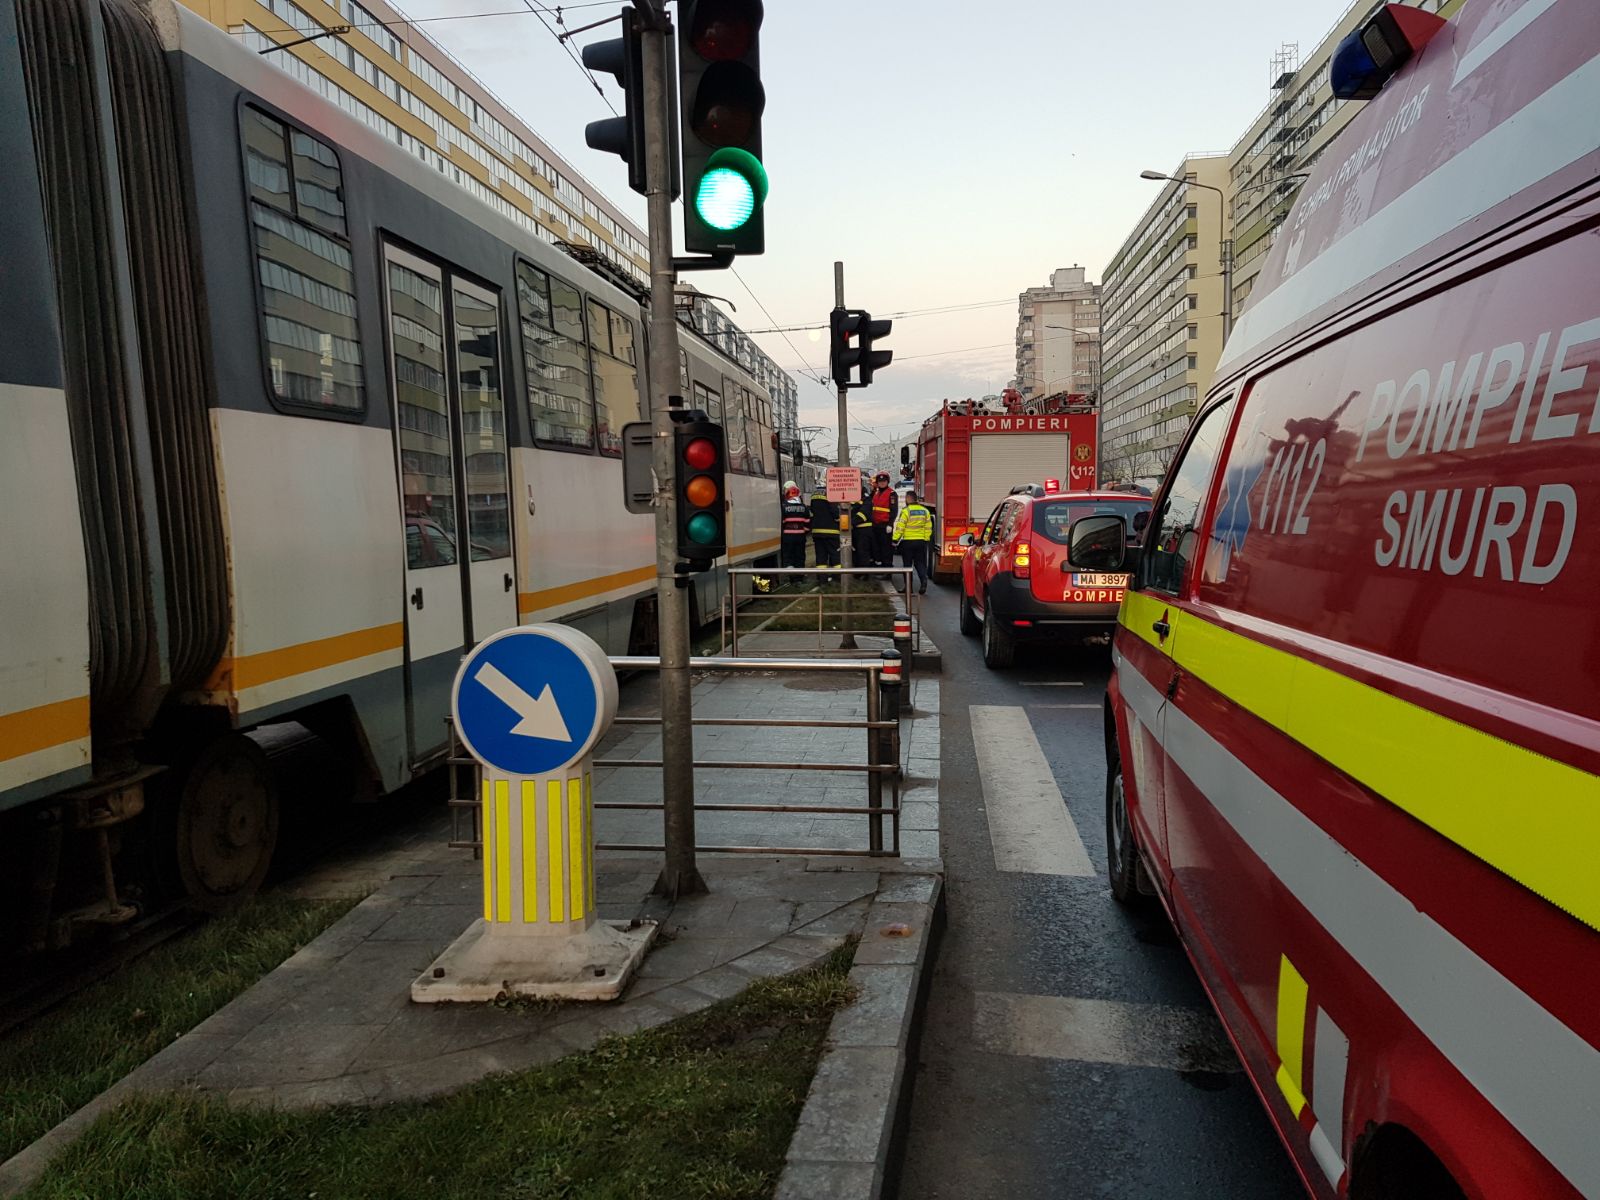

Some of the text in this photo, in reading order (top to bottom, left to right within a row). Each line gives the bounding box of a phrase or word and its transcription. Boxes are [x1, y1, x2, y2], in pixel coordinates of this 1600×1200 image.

[1363, 83, 1430, 169] AJUTOR
[972, 418, 1068, 430] POMPIERI
[1076, 466, 1095, 476] 112
[1269, 437, 1326, 535] 112
[1374, 483, 1577, 585] SMURD
[1080, 574, 1125, 585] MAI 3897
